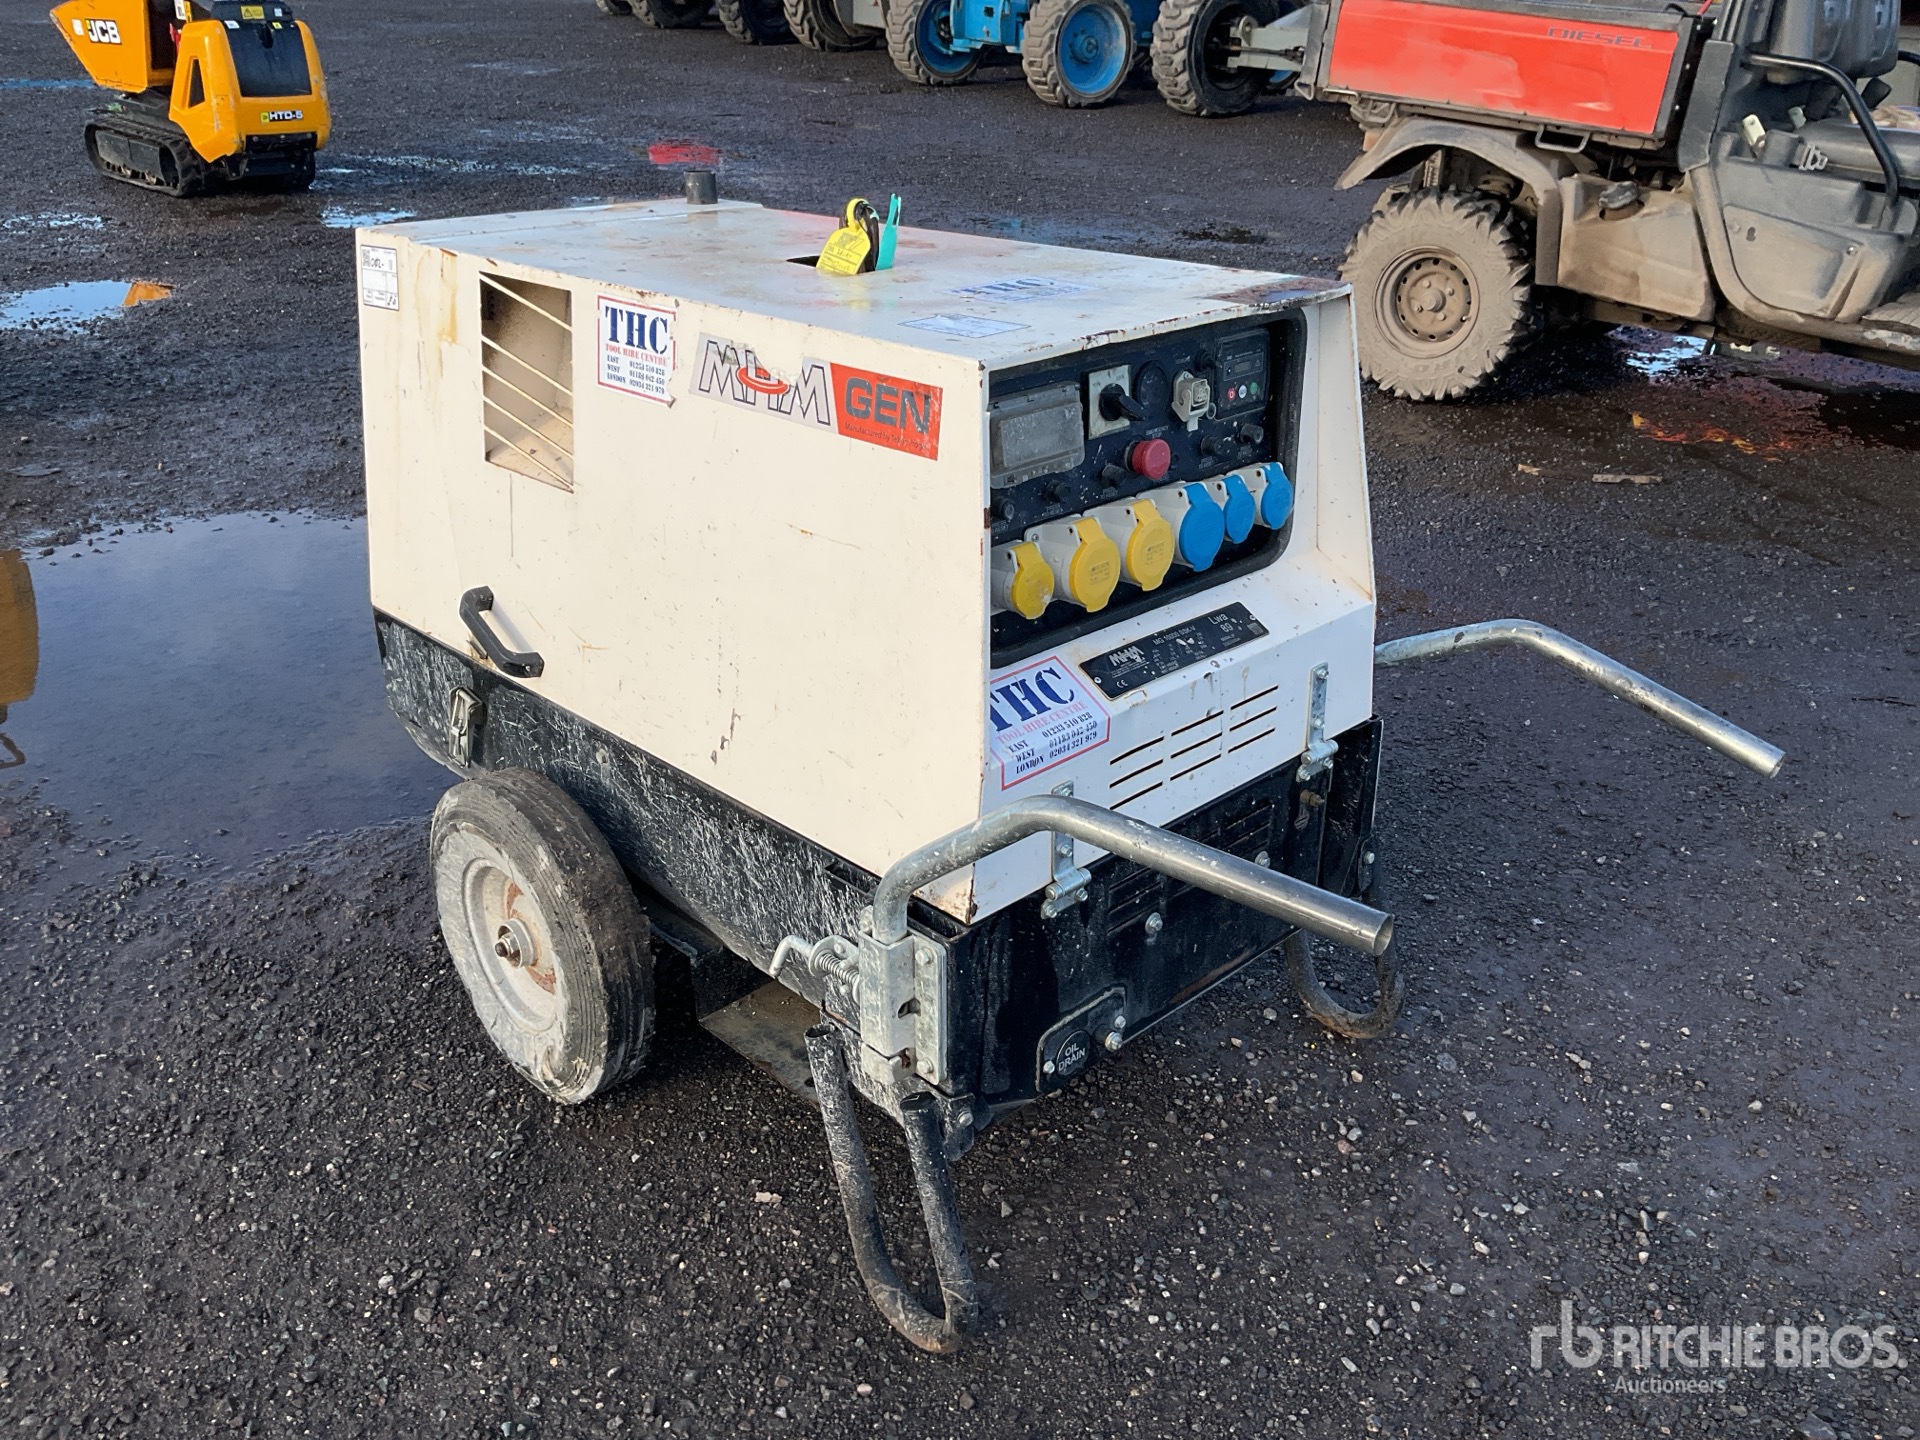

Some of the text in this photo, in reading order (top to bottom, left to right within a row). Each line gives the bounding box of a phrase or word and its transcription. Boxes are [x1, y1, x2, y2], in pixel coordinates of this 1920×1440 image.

[87, 20, 121, 44] JCB
[1547, 27, 1652, 49] DIESEL
[269, 110, 303, 121] HTD-5
[605, 305, 668, 354] THC
[605, 343, 667, 366] TOOL HIRE CENTRE
[607, 354, 619, 364] EAST
[607, 363, 620, 373] WEST
[607, 372, 626, 383] LONDON
[845, 377, 932, 435] GEN
[1207, 614, 1229, 625] Lwa
[1220, 622, 1234, 633] 89
[996, 701, 1089, 744] TOOL HIRE CENTRE
[1008, 740, 1029, 753] EAST
[1041, 723, 1066, 738] 01233
[1064, 718, 1079, 729] 510
[1015, 748, 1035, 762] WEST
[1016, 755, 1045, 774] LONDON
[1071, 738, 1084, 749] 321
[1058, 1047, 1086, 1072] DRAIN
[1064, 1043, 1080, 1057] OIL
